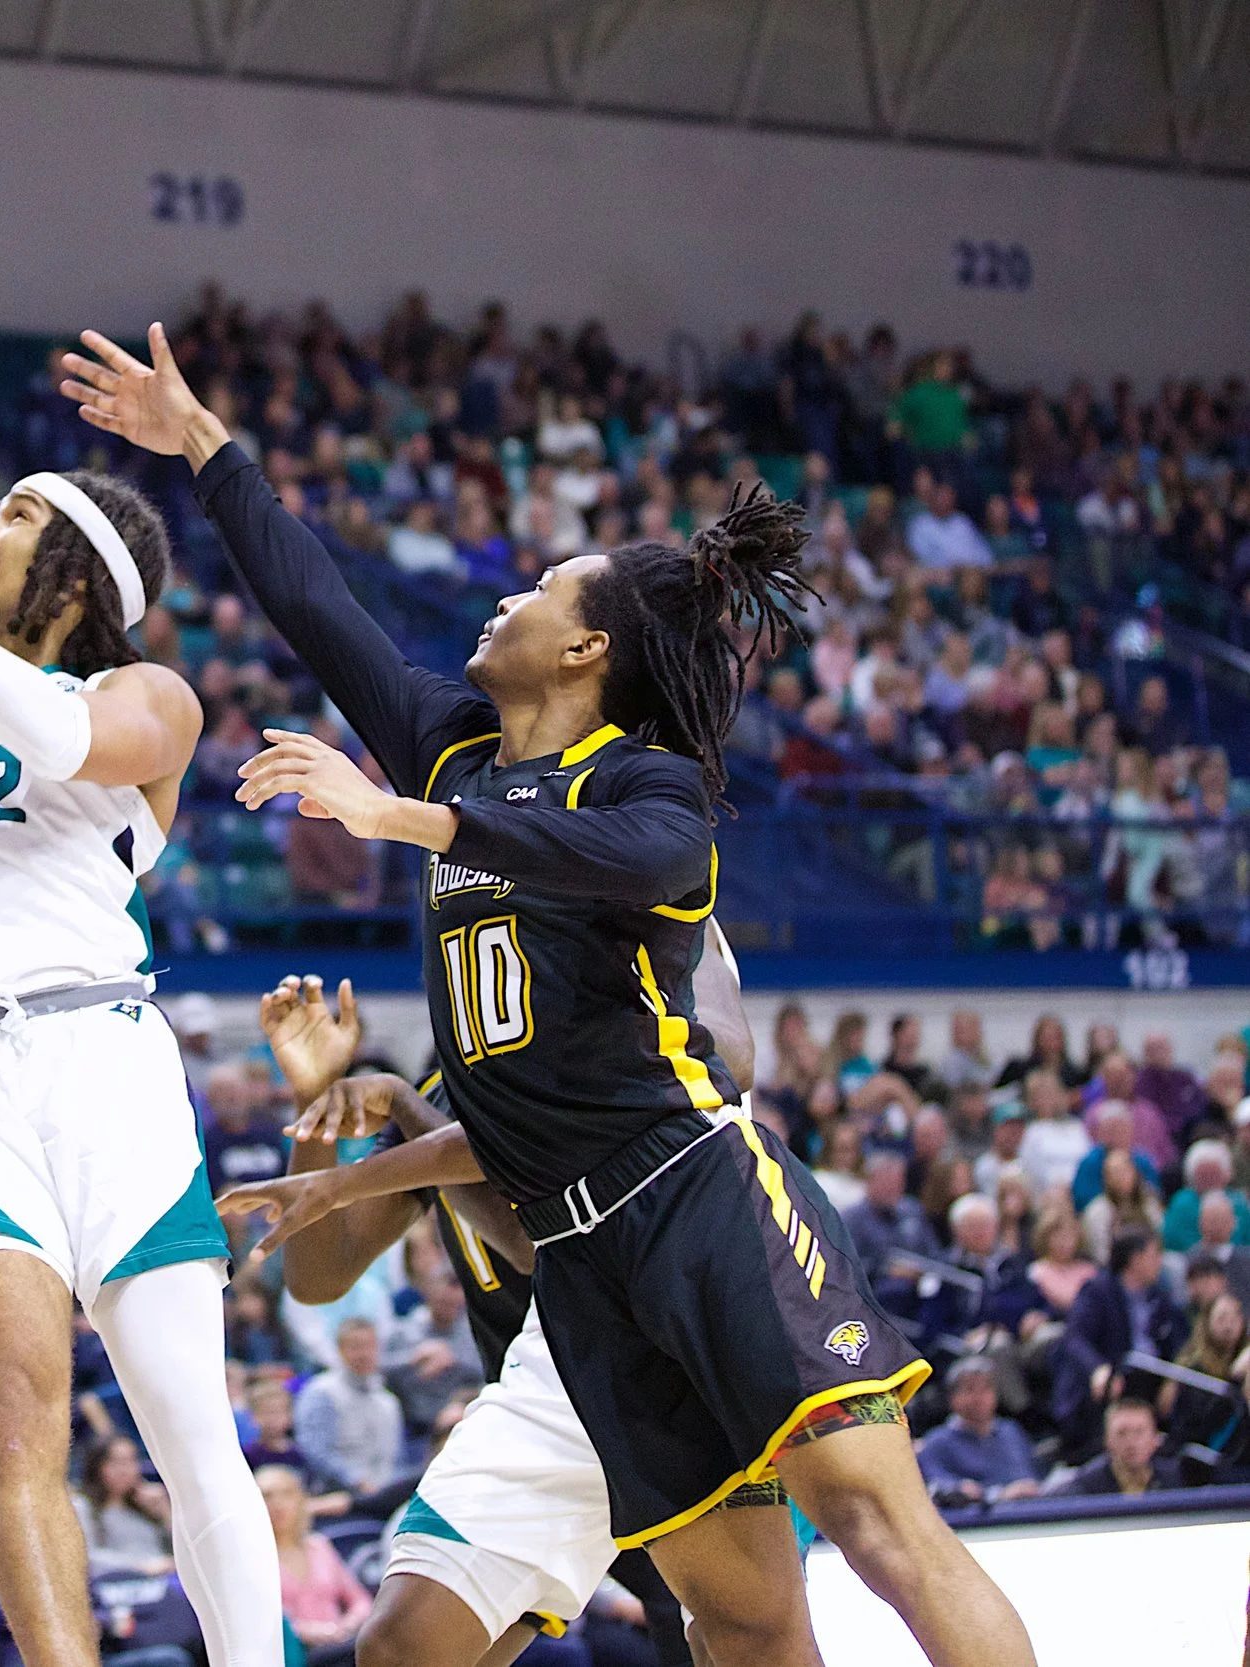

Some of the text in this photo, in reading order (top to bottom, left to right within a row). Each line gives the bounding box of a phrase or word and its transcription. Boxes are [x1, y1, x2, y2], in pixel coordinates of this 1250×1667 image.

[150, 172, 243, 226] 219
[952, 240, 1031, 292] 220
[506, 787, 539, 801] CAA
[440, 914, 534, 1065] 10
